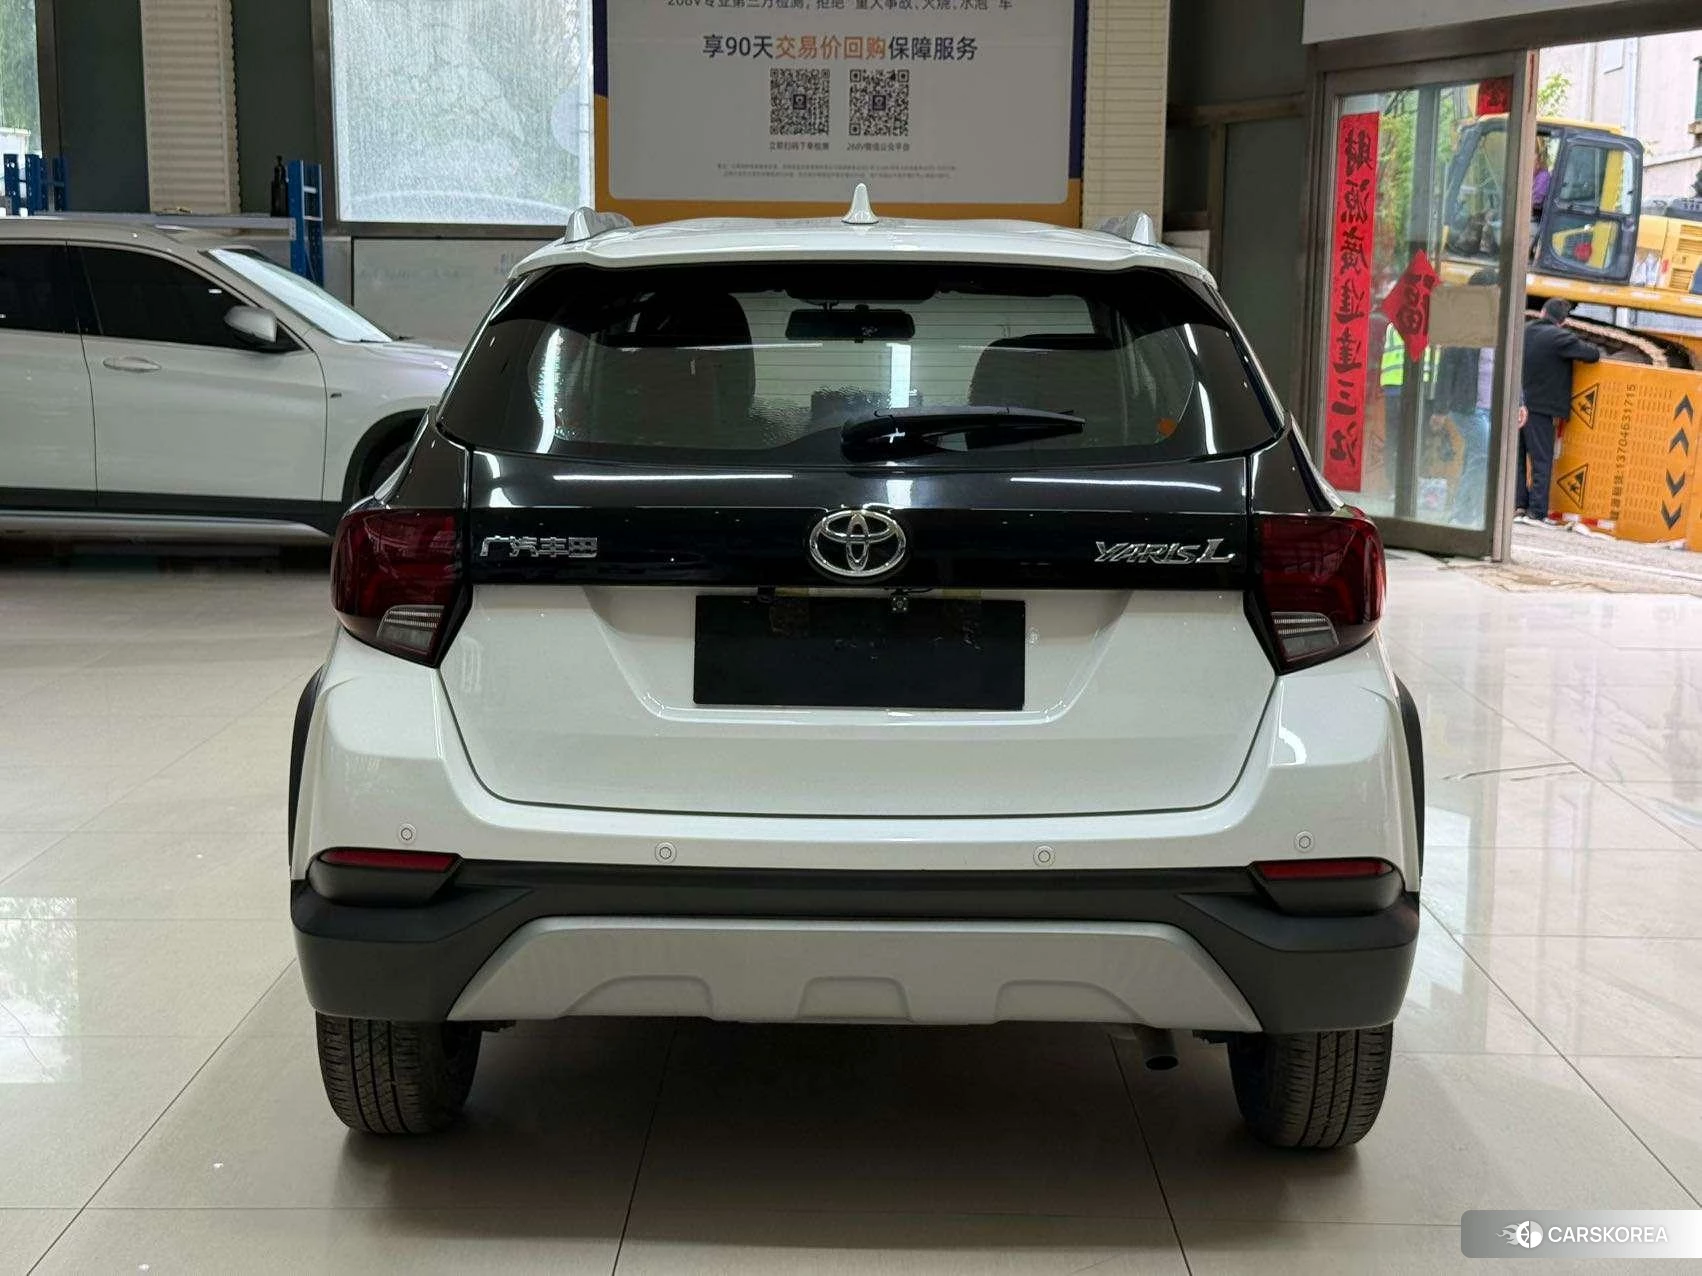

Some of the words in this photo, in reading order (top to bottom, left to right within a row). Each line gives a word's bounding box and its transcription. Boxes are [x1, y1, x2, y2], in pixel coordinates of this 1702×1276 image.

[702, 34, 979, 62] 享90天交易价回购保障服务
[479, 535, 598, 558] 广汽丰田
